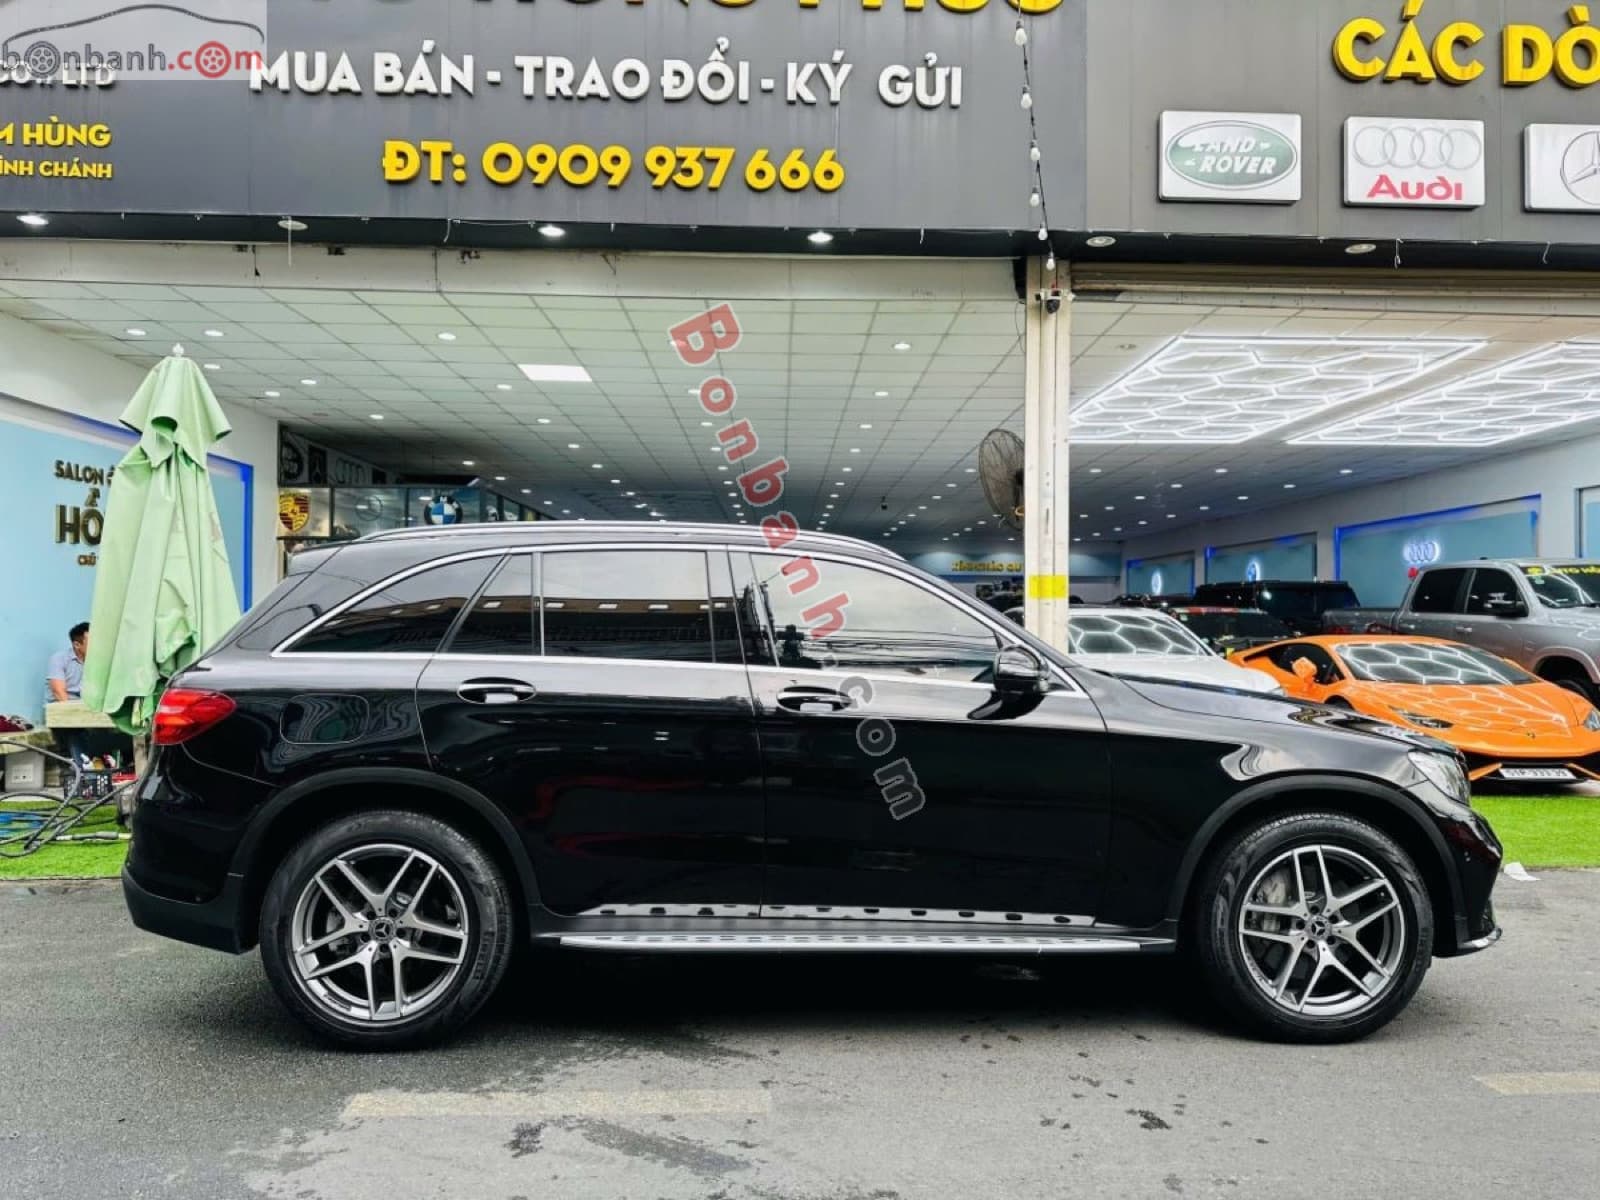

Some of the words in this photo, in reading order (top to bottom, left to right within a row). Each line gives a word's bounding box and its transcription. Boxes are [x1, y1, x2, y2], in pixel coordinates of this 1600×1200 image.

[1334, 0, 1485, 81] CÁC
[1503, 4, 1600, 86] DÒ
[249, 50, 362, 95] MUA
[373, 40, 474, 96] BÁN
[514, 56, 651, 99] TRAO
[661, 36, 750, 102] ĐỔI
[786, 49, 853, 103] KÝ
[878, 51, 963, 108] GỬI
[23, 115, 112, 147] HÙNG
[39, 157, 113, 178] CHÁNH
[382, 140, 467, 183] ĐT:
[481, 142, 633, 187] 0909
[644, 145, 736, 188] 937
[744, 149, 846, 191] 666
[1199, 154, 1277, 175] ROVER
[1368, 173, 1463, 201] Audi
[55, 460, 105, 485] SALON
